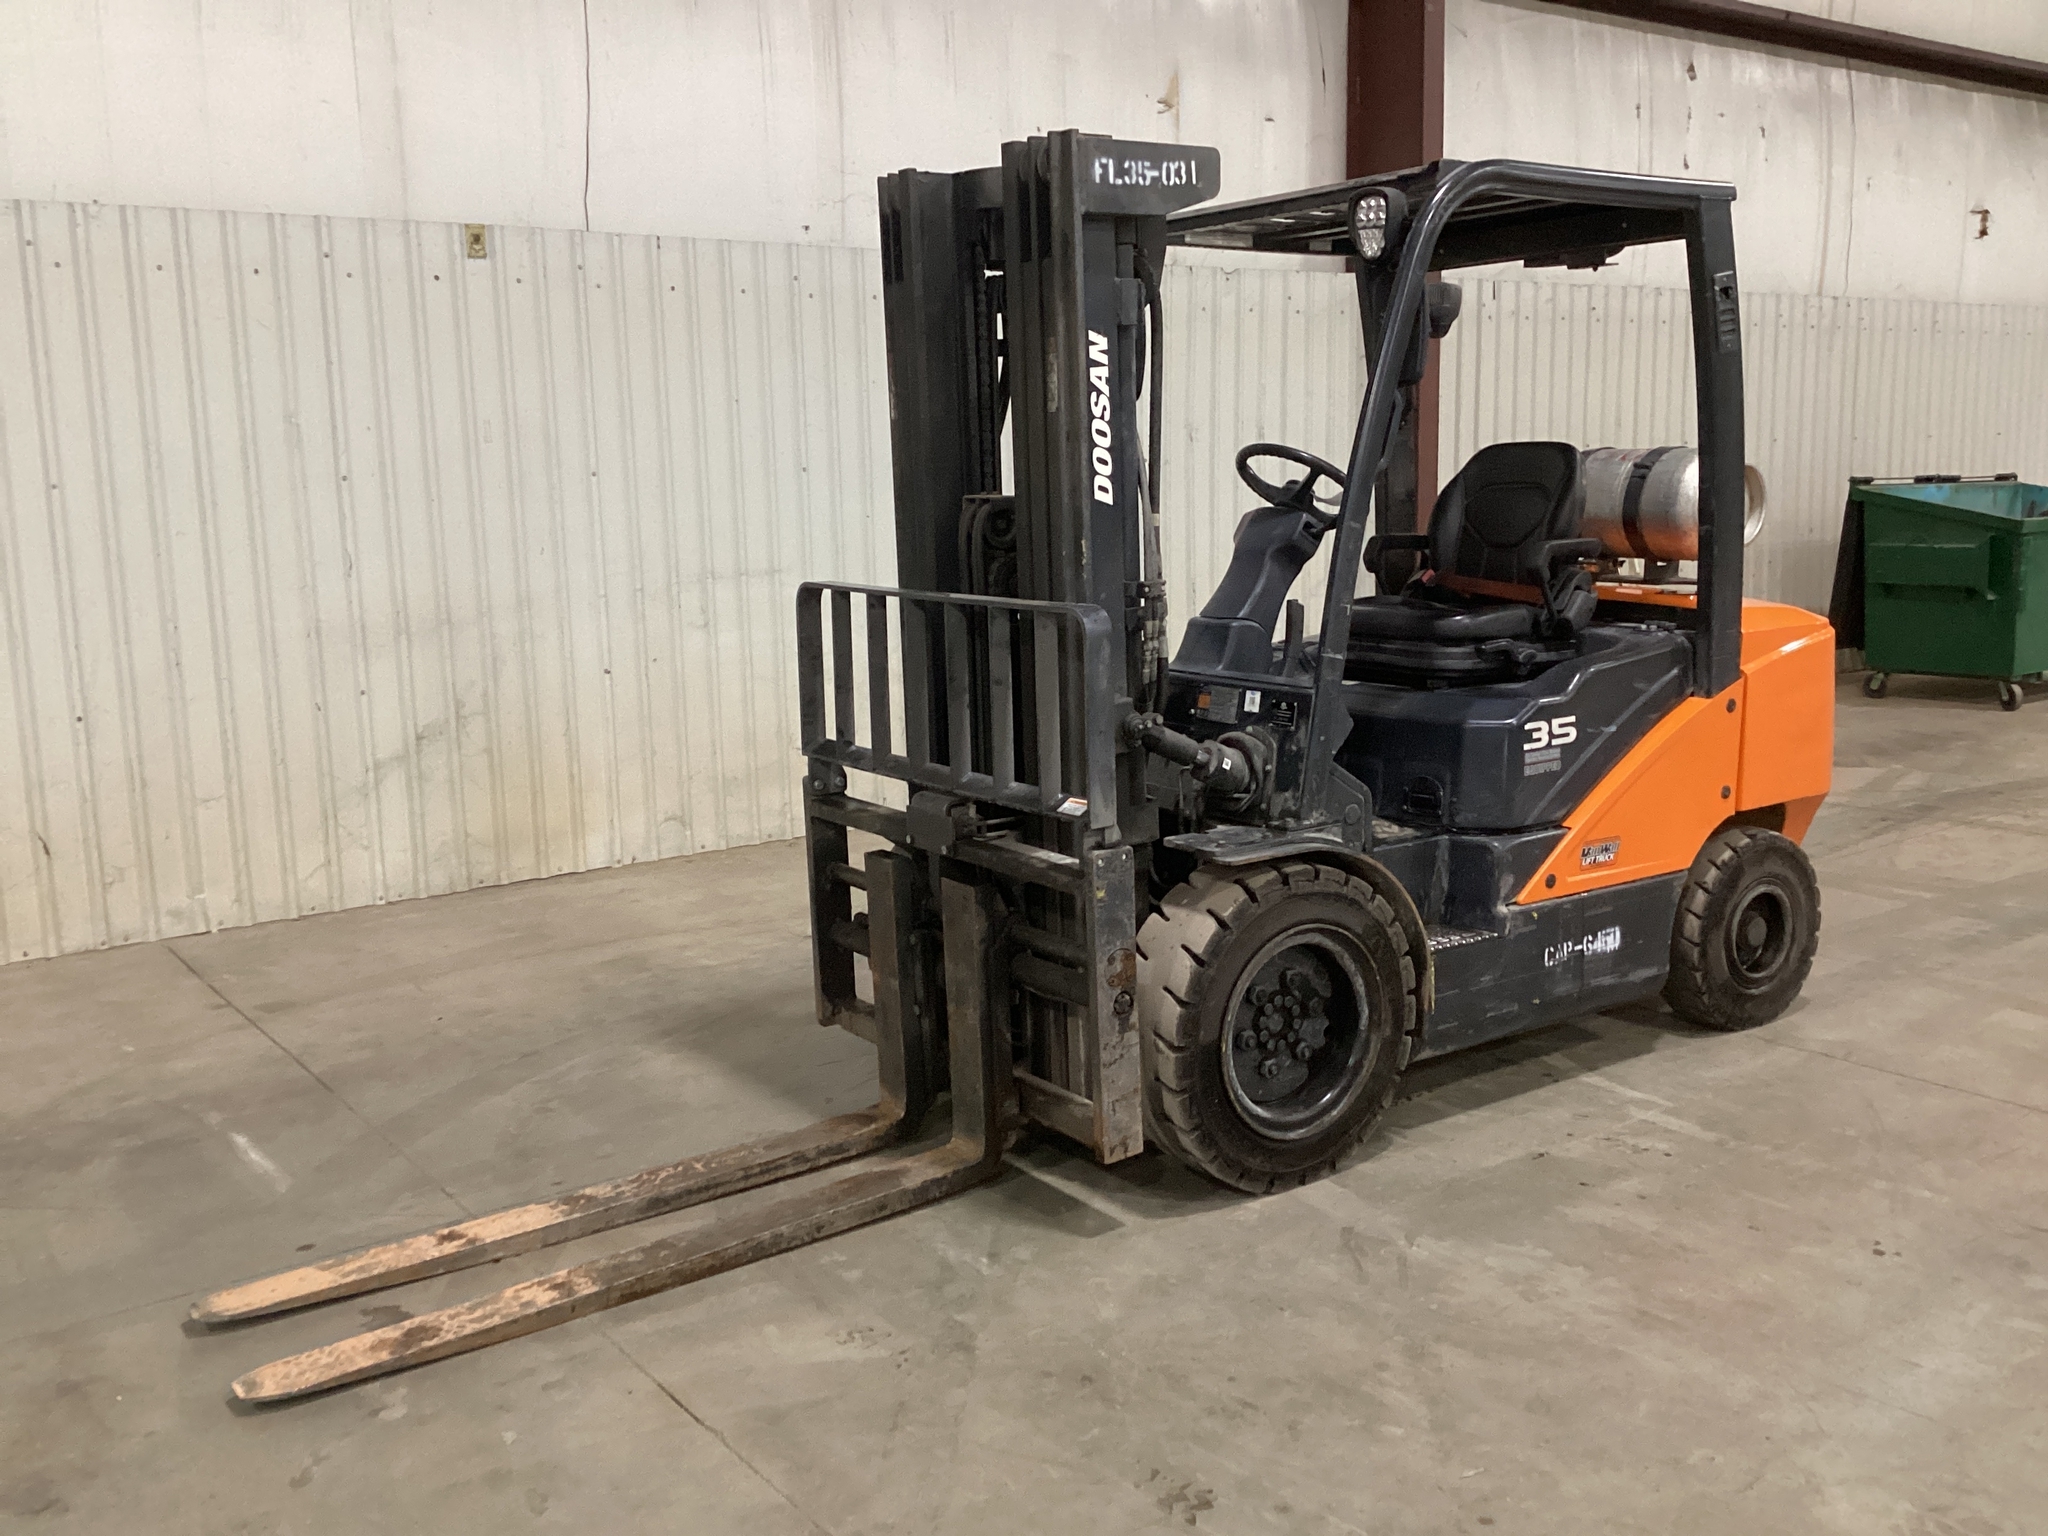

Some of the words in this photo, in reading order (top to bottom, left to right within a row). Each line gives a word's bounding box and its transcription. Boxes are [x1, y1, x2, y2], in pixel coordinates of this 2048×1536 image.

[1094, 157, 1197, 186] FL35-031
[1088, 329, 1114, 506] DOOSAN
[1523, 715, 1577, 751] 35
